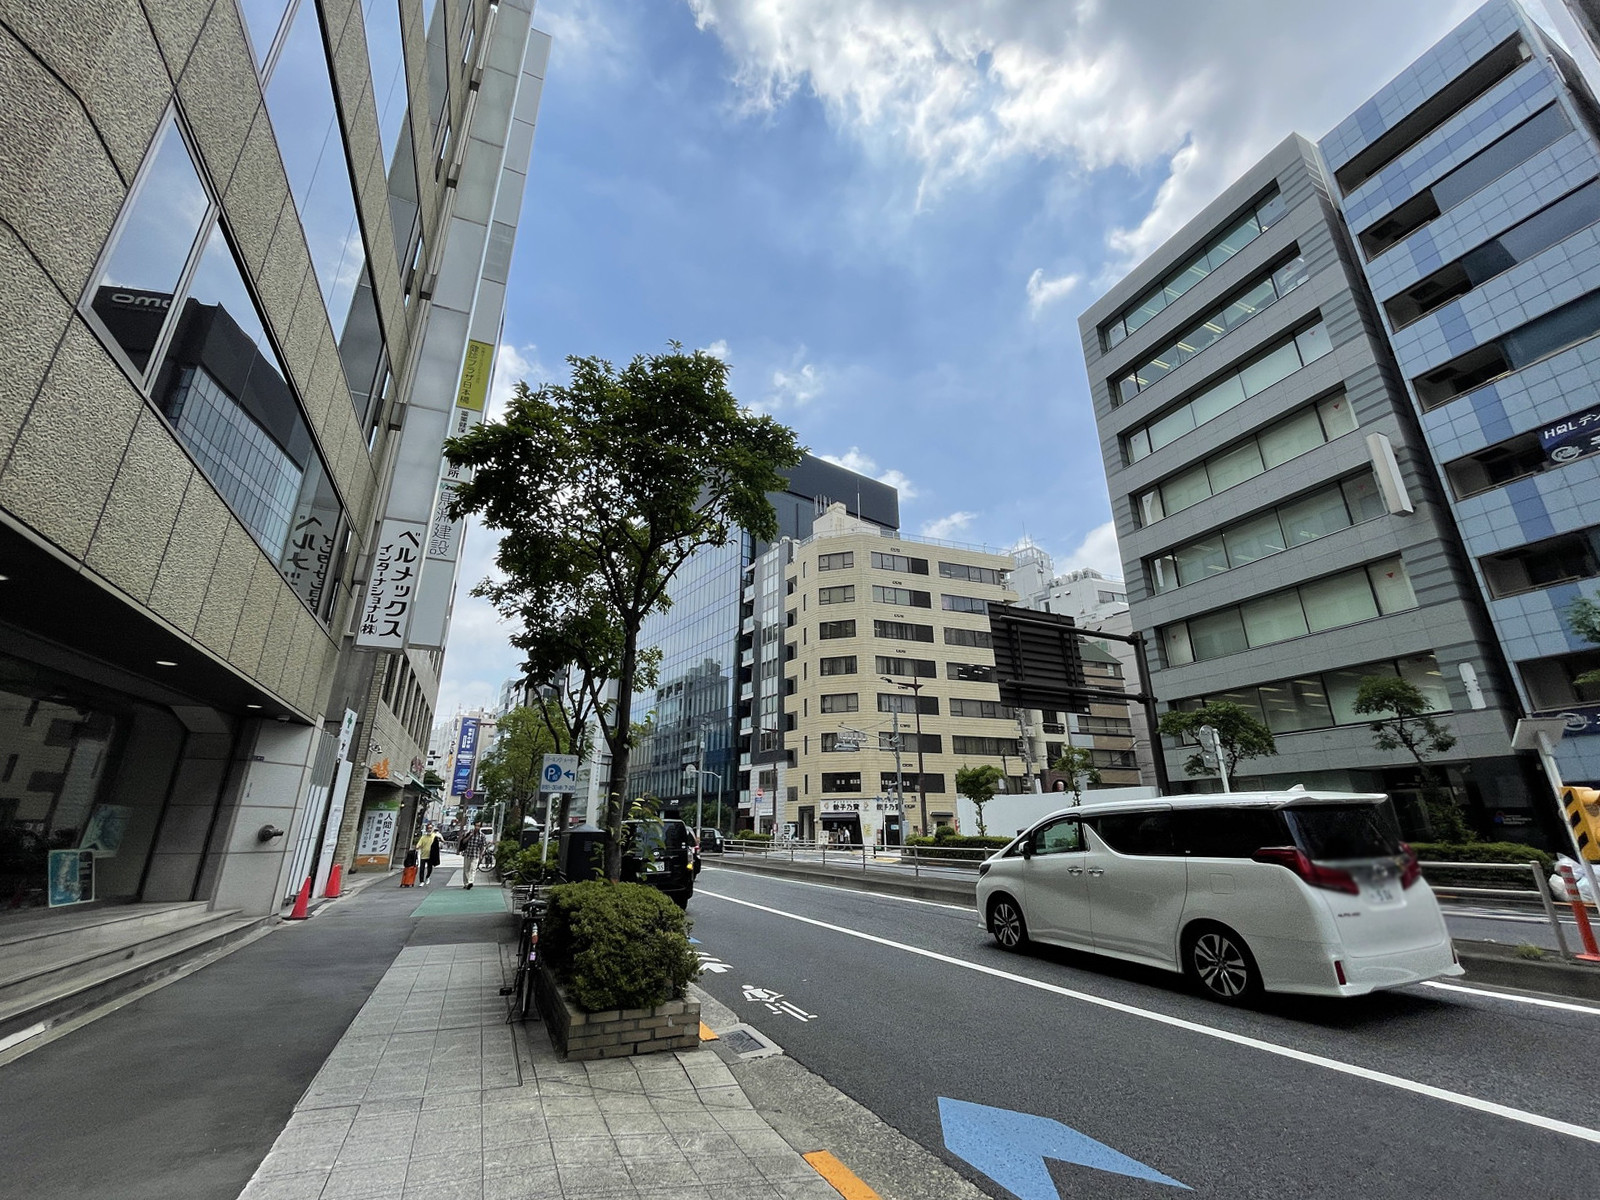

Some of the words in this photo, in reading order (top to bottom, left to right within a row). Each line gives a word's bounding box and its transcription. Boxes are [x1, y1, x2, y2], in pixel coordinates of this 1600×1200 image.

[379, 531, 421, 638] ベルメックス
[379, 812, 393, 853] 人間ドック
